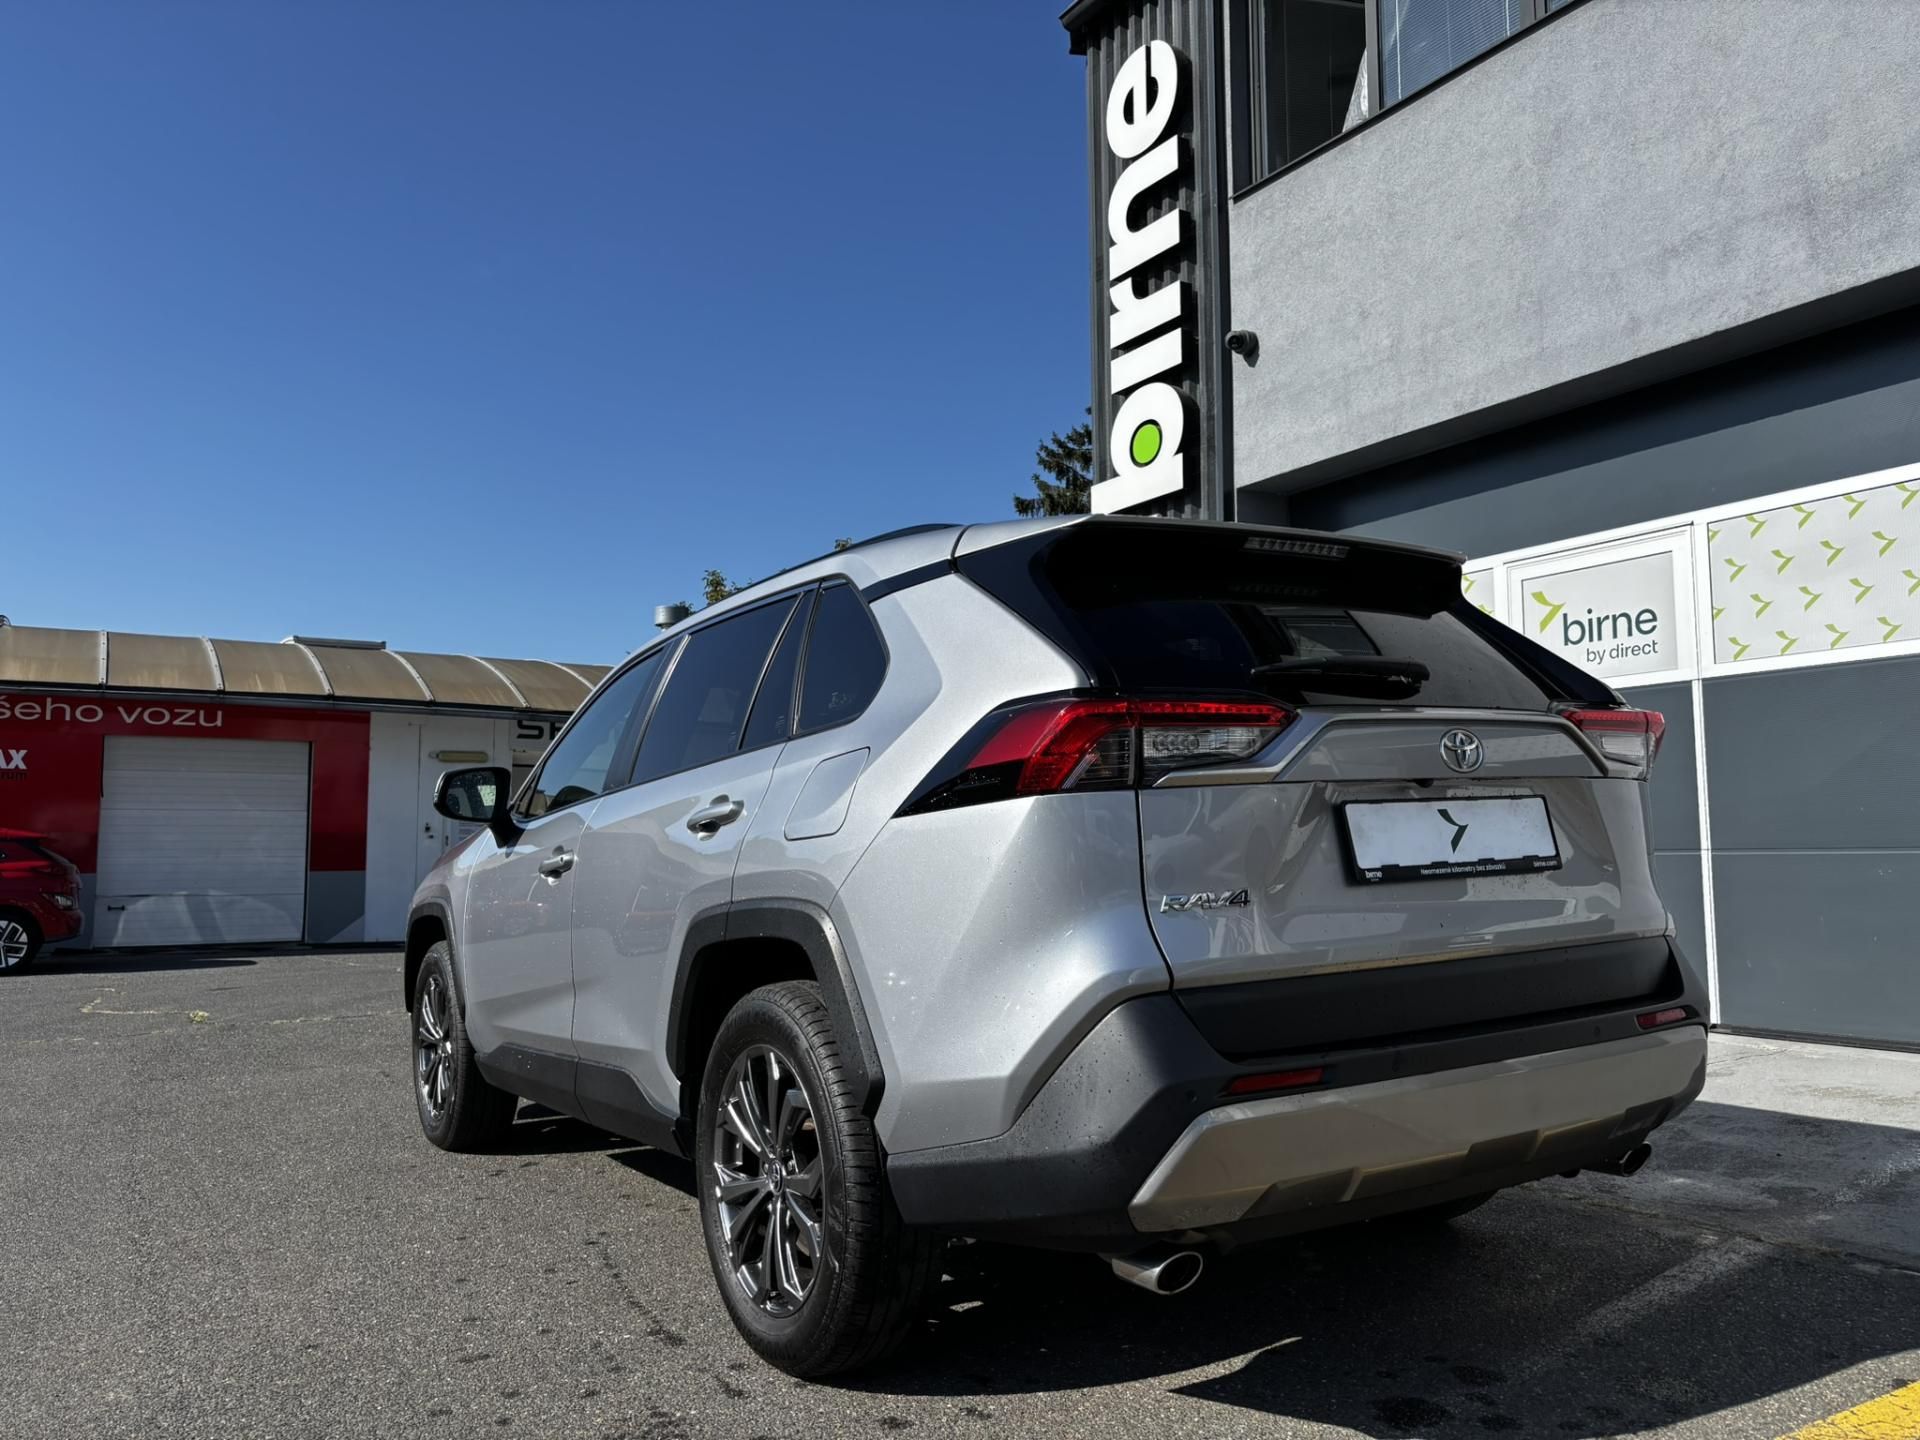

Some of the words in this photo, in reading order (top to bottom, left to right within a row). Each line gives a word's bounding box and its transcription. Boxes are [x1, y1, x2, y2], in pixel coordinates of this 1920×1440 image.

[1091, 39, 1184, 515] birne
[1562, 608, 1658, 646] birne
[1586, 648, 1606, 665] by
[1609, 639, 1658, 659] direct
[117, 706, 223, 727] vozu
[1160, 889, 1250, 913] RAV4
